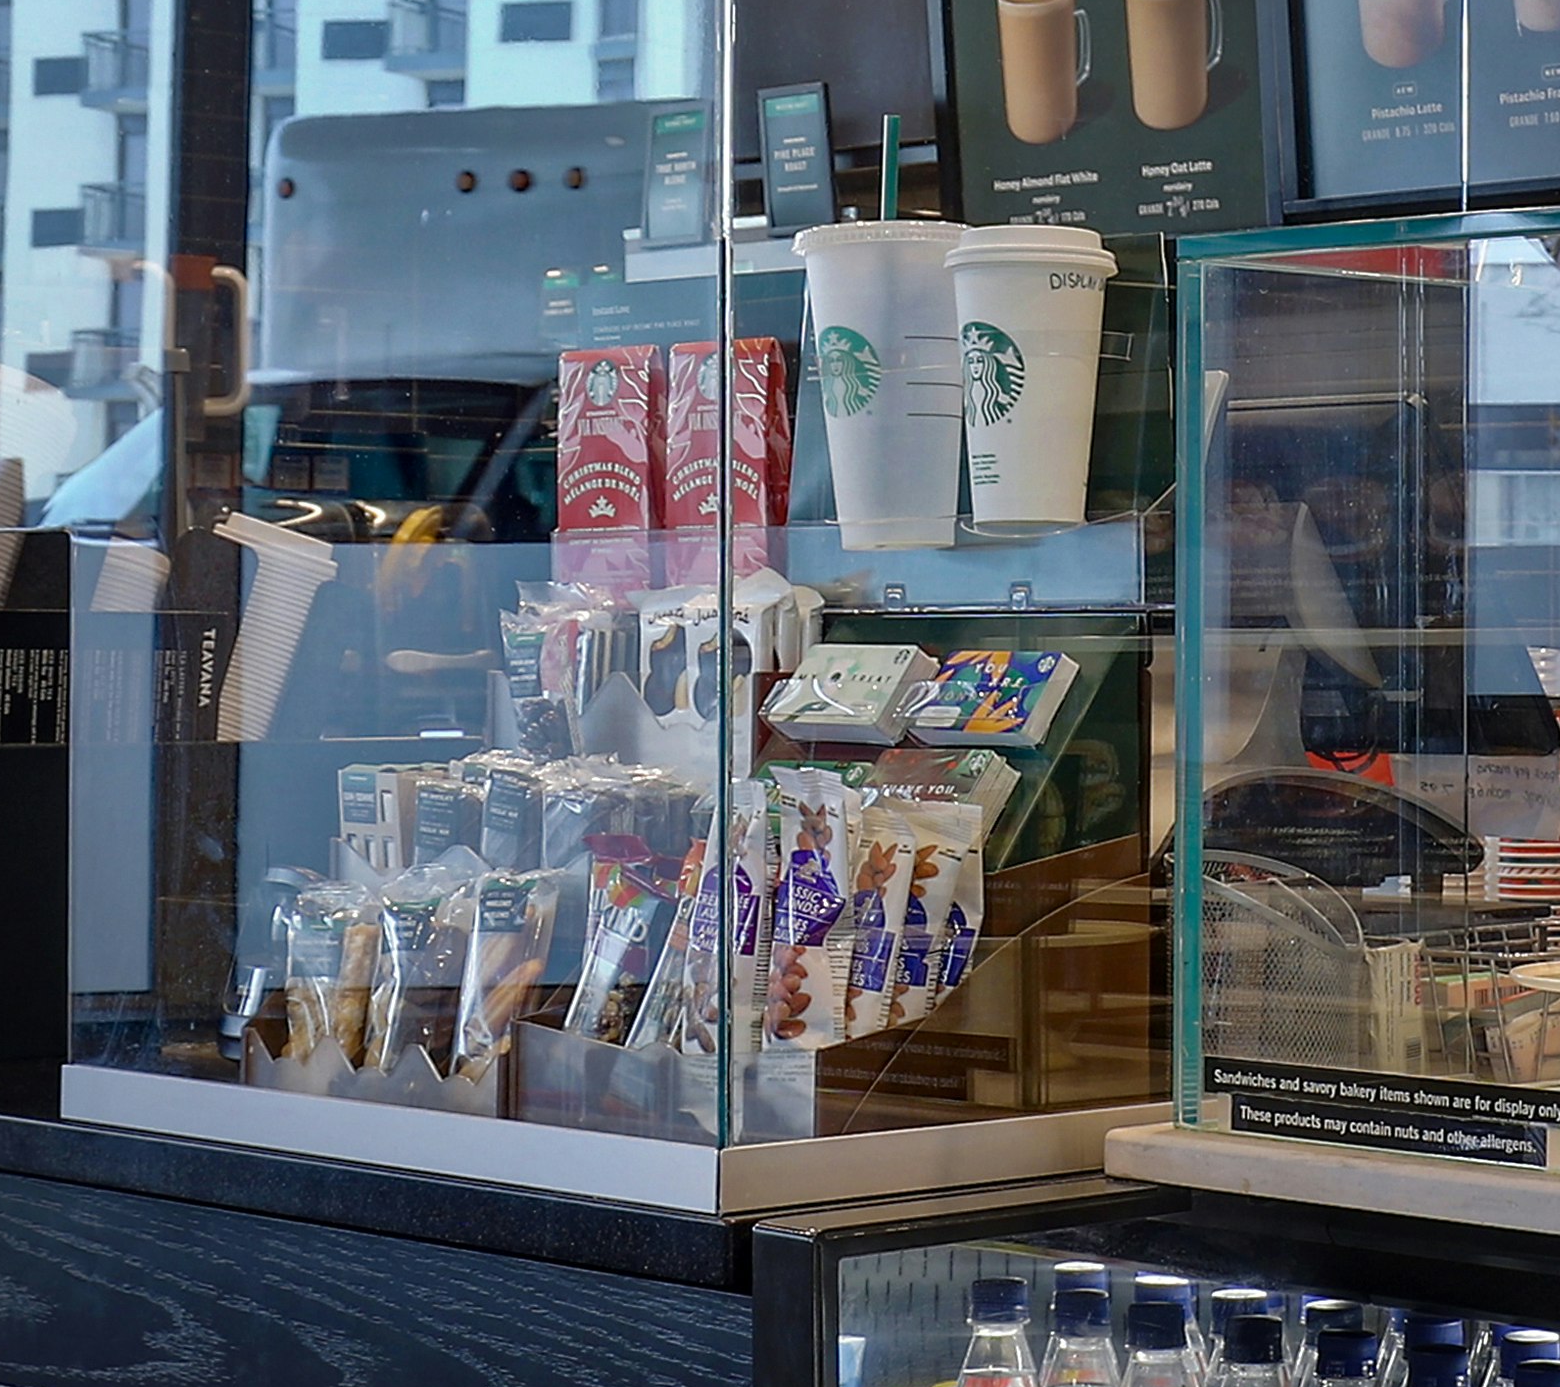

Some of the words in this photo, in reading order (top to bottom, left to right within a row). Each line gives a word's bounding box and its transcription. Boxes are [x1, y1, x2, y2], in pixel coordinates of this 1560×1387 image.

[1371, 106, 1415, 120] Pistachio
[1417, 103, 1442, 114] Latte
[1499, 90, 1544, 105] Pistachio
[564, 463, 612, 489] CHRISTMAS
[614, 463, 640, 484] BLEND
[198, 627, 216, 708] TEAVANA
[1214, 1068, 1277, 1090] Sandwiches
[1279, 1076, 1300, 1092] and
[1302, 1080, 1337, 1098] savory
[1340, 1082, 1377, 1103] bakery
[1380, 1087, 1410, 1104] items
[1413, 1090, 1449, 1108] shown
[1452, 1096, 1472, 1110] are
[1475, 1096, 1492, 1112] for
[1494, 1097, 1536, 1118] display
[1240, 1105, 1271, 1123] These
[1274, 1111, 1321, 1130] products
[1324, 1117, 1348, 1135] may
[1350, 1118, 1391, 1137] contain
[1395, 1125, 1419, 1140] nuts
[1422, 1126, 1444, 1142] and
[1447, 1129, 1477, 1145] other
[1479, 1134, 1537, 1154] allergens.
